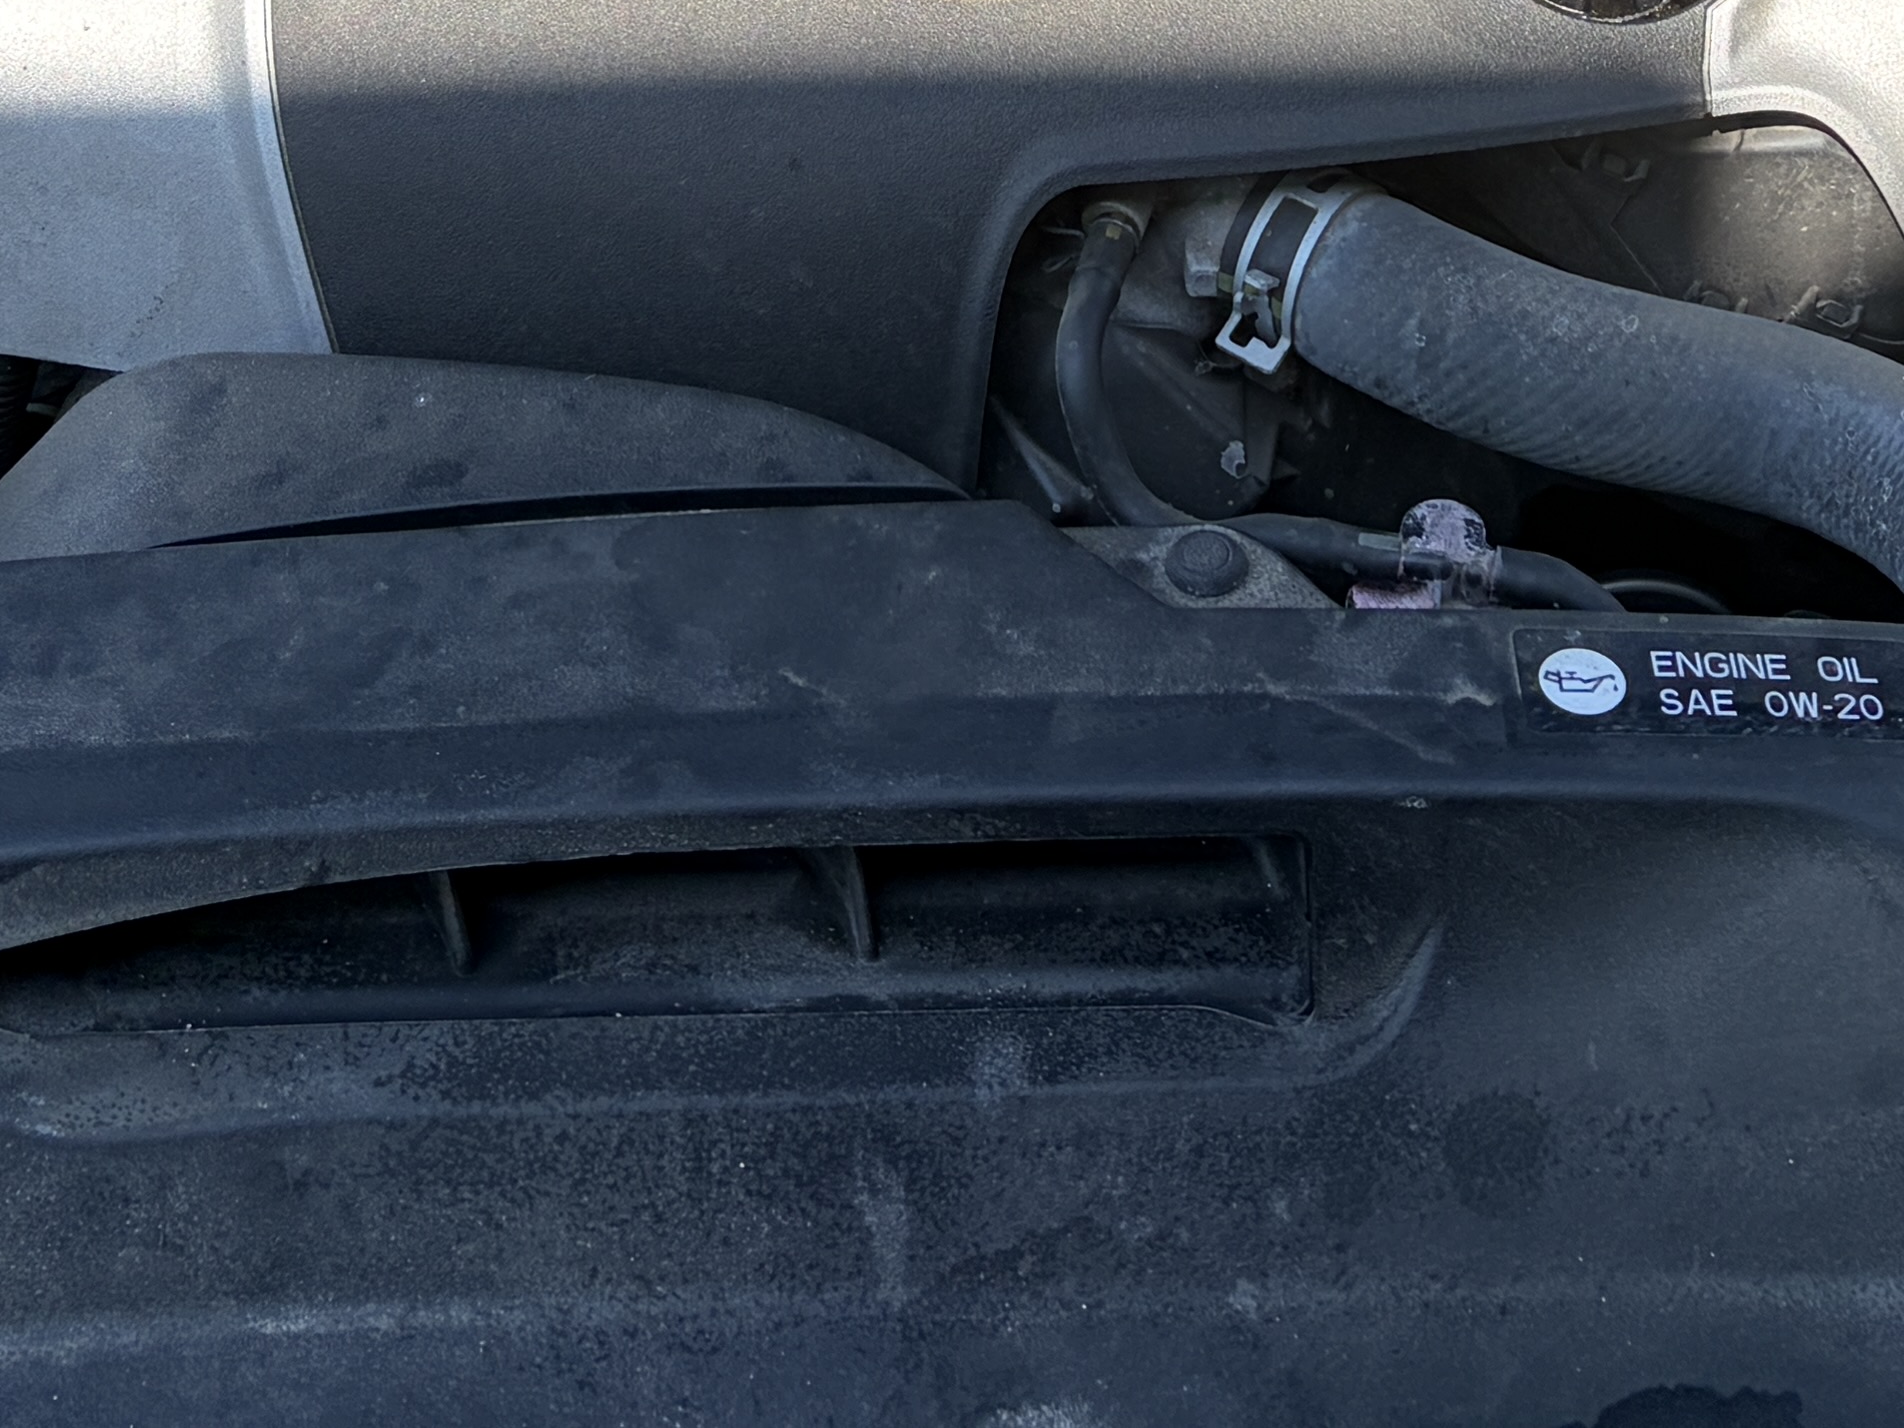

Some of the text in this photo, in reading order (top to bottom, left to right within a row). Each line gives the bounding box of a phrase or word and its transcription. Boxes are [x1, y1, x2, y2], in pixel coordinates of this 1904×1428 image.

[1649, 649, 1879, 686] ENGINE OIL
[1658, 688, 1885, 722] SAE 0W-20
